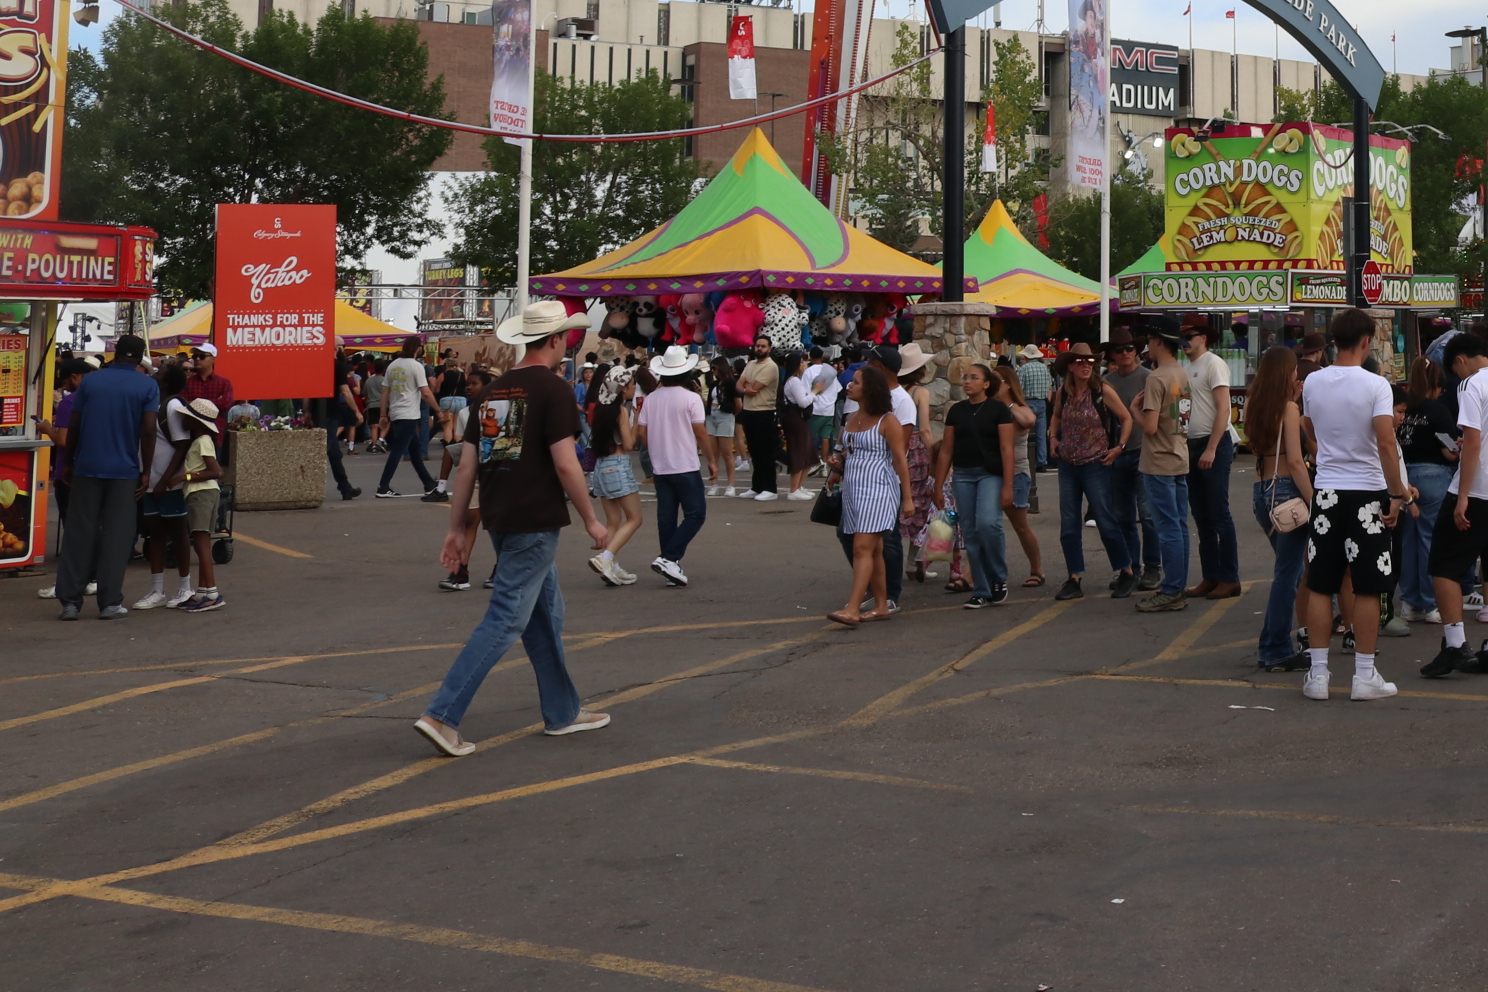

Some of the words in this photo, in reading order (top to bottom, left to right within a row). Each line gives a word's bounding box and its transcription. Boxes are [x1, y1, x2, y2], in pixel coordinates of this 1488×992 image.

[1318, 12, 1358, 68] PARK
[1174, 160, 1236, 196] CORN
[1241, 158, 1303, 192] DOGS
[1198, 216, 1228, 231] FRESH
[1230, 216, 1279, 229] SQUEEZED
[26, 252, 115, 280] POUTINE
[424, 269, 446, 281] TURKEY
[447, 268, 464, 279] LEGS
[240, 256, 312, 304] Yahoo
[1146, 275, 1284, 304] CORNDOGS
[1363, 274, 1381, 290] STOP
[1413, 282, 1455, 302] CORNDOGS
[226, 314, 273, 326] THANKS
[276, 314, 298, 325] FOR
[302, 313, 324, 324] THE
[226, 326, 326, 347] MEMORIES
